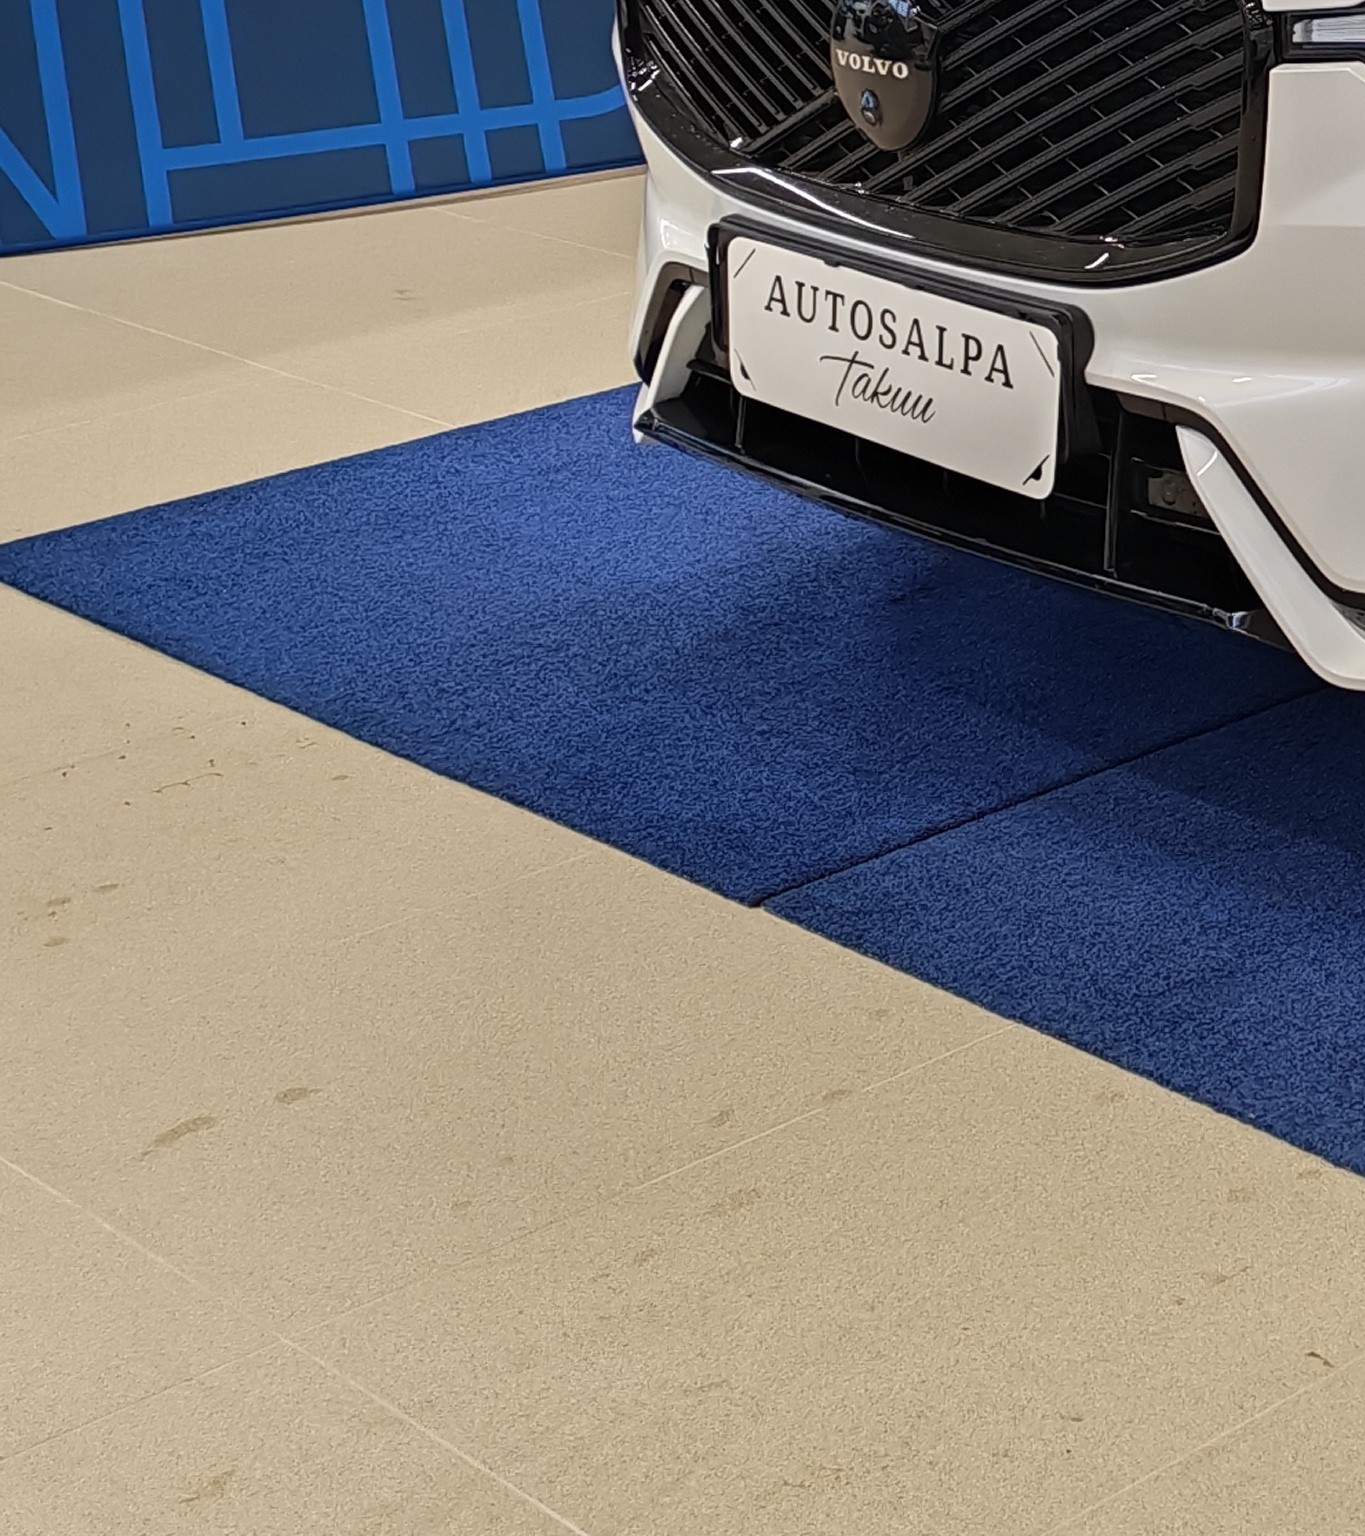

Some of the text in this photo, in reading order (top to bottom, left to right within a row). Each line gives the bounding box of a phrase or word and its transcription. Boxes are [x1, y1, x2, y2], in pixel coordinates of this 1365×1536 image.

[836, 49, 909, 79] VOLVO
[764, 274, 1015, 390] AUTOSALPA
[820, 350, 936, 425] Takuu
